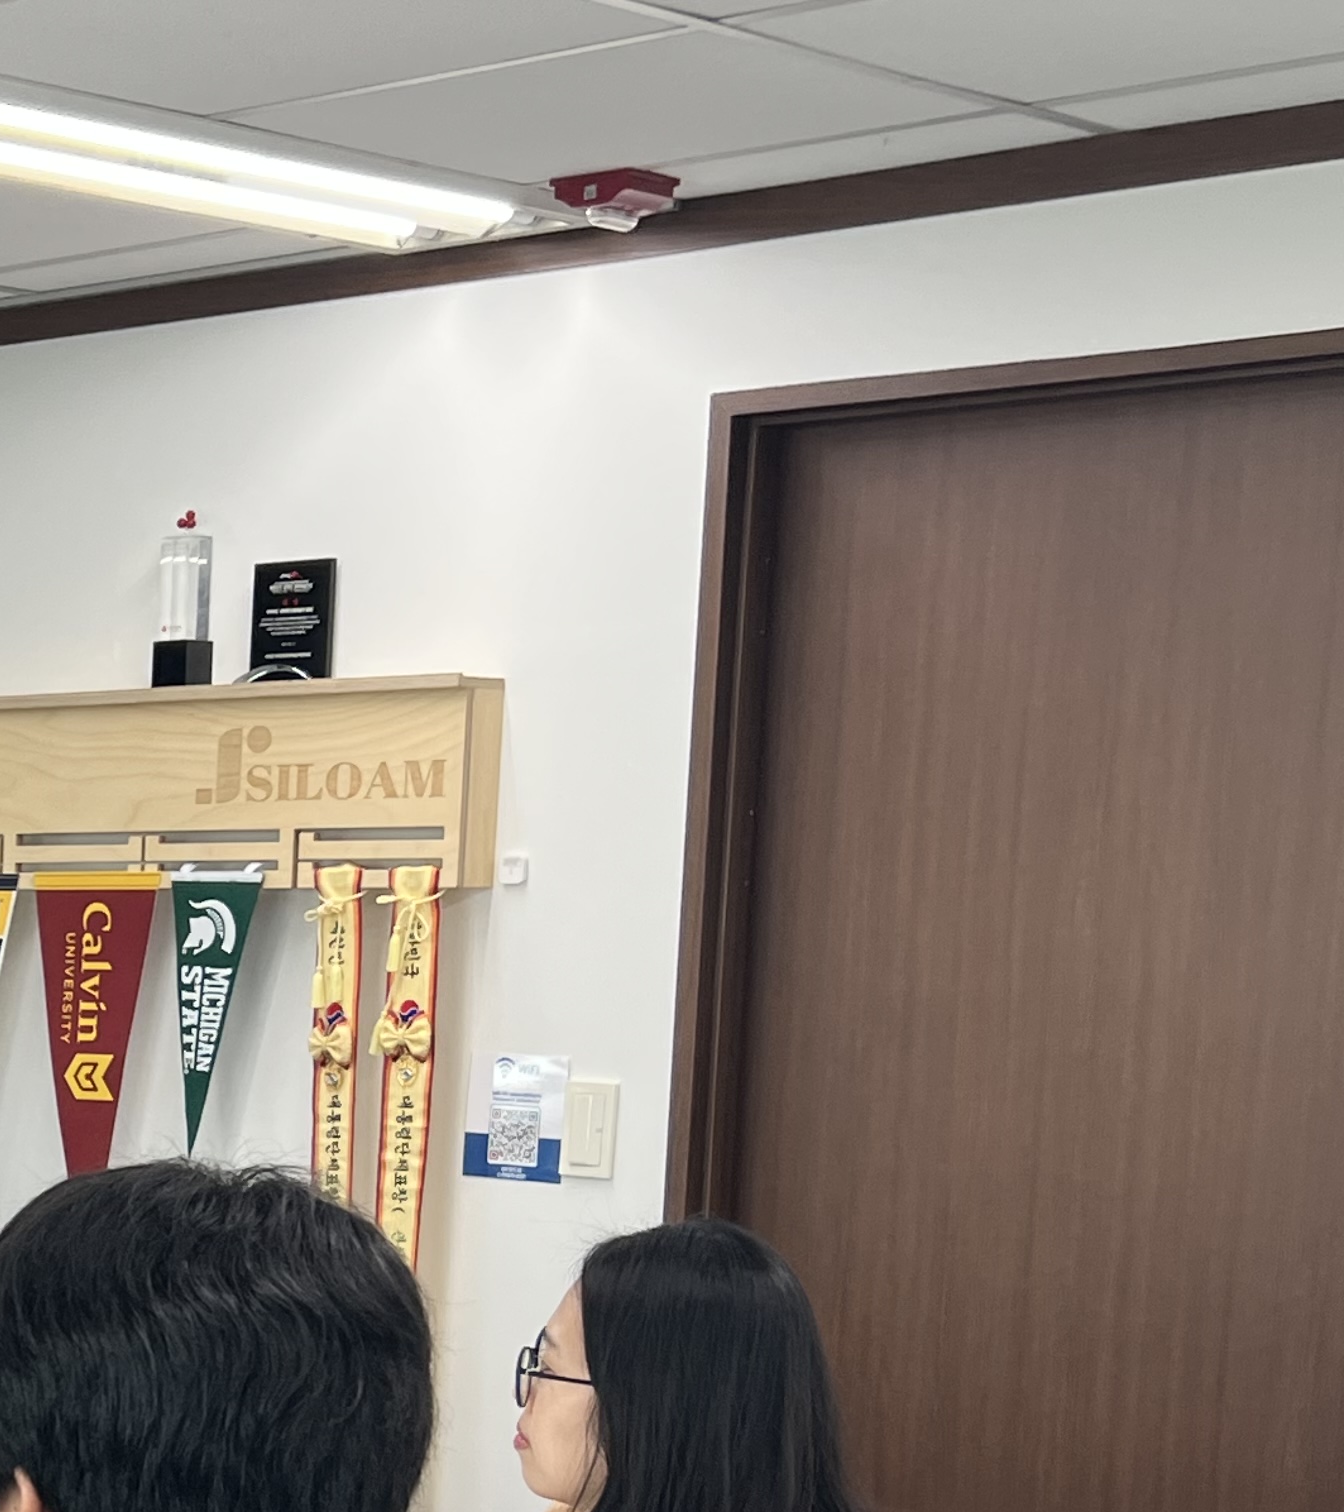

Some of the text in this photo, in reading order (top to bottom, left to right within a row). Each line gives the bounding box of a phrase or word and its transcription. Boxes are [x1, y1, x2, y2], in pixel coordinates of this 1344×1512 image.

[245, 759, 448, 802] SILOAM
[59, 932, 77, 1044] UNIVERSITY
[77, 902, 113, 1044] Calvin
[180, 965, 204, 1070] STATE
[195, 966, 234, 1074] MICHIGAN
